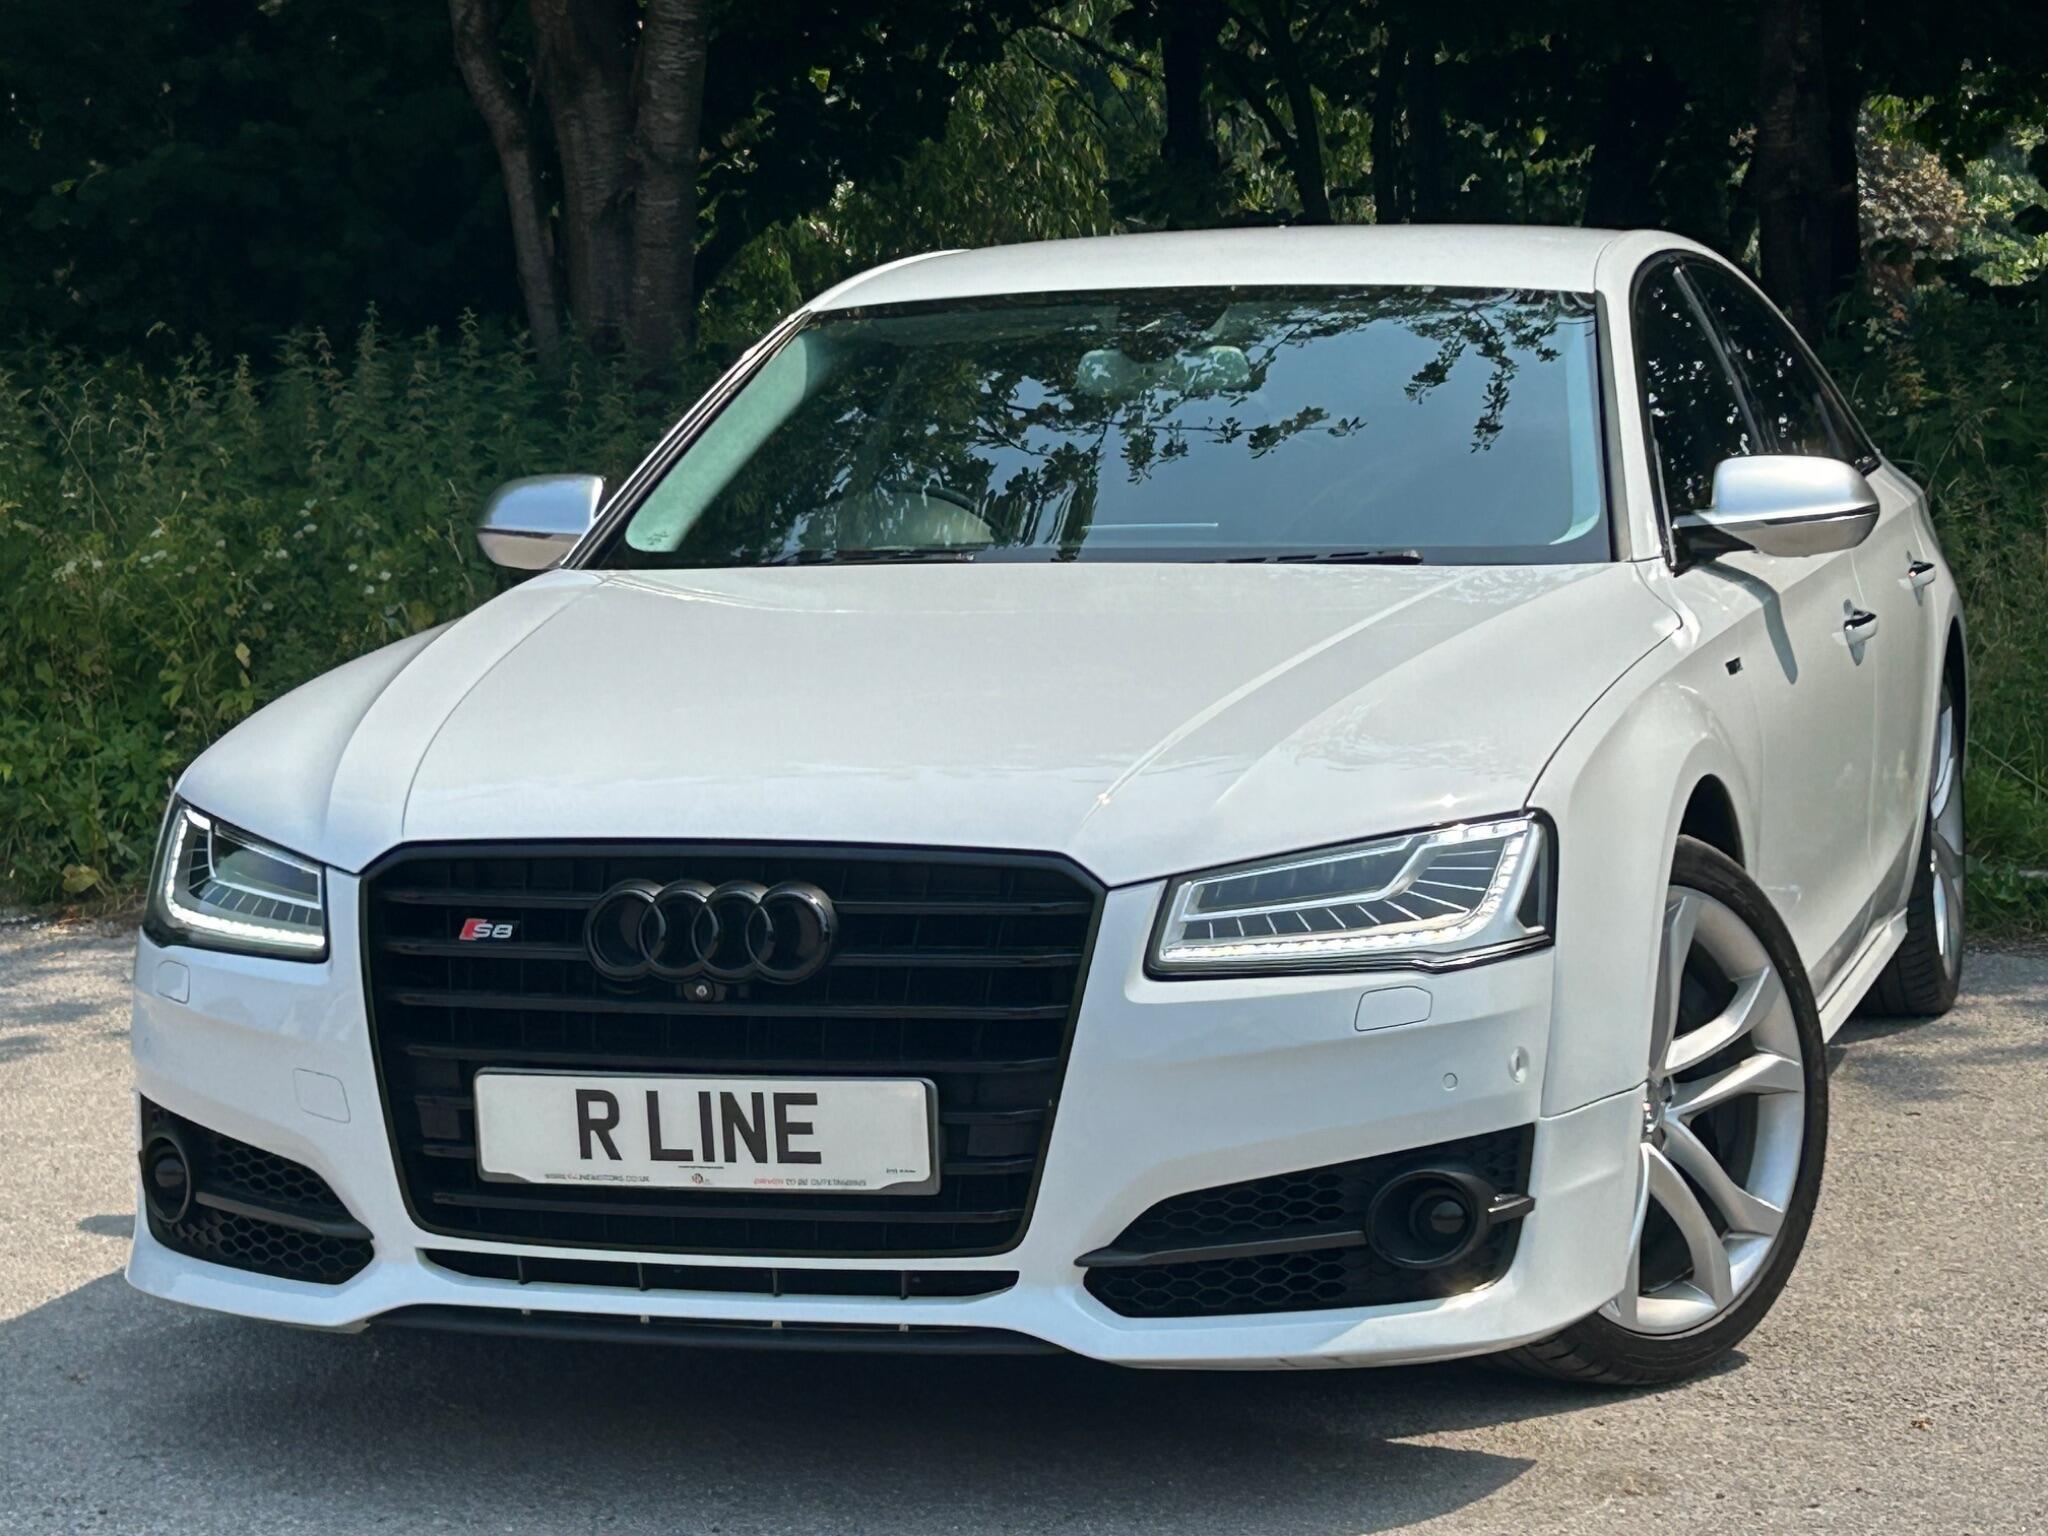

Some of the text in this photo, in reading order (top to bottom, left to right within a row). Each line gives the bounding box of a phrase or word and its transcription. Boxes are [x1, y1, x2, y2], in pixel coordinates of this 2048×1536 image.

[472, 923, 513, 939] S8
[575, 1088, 822, 1165] R LINE
